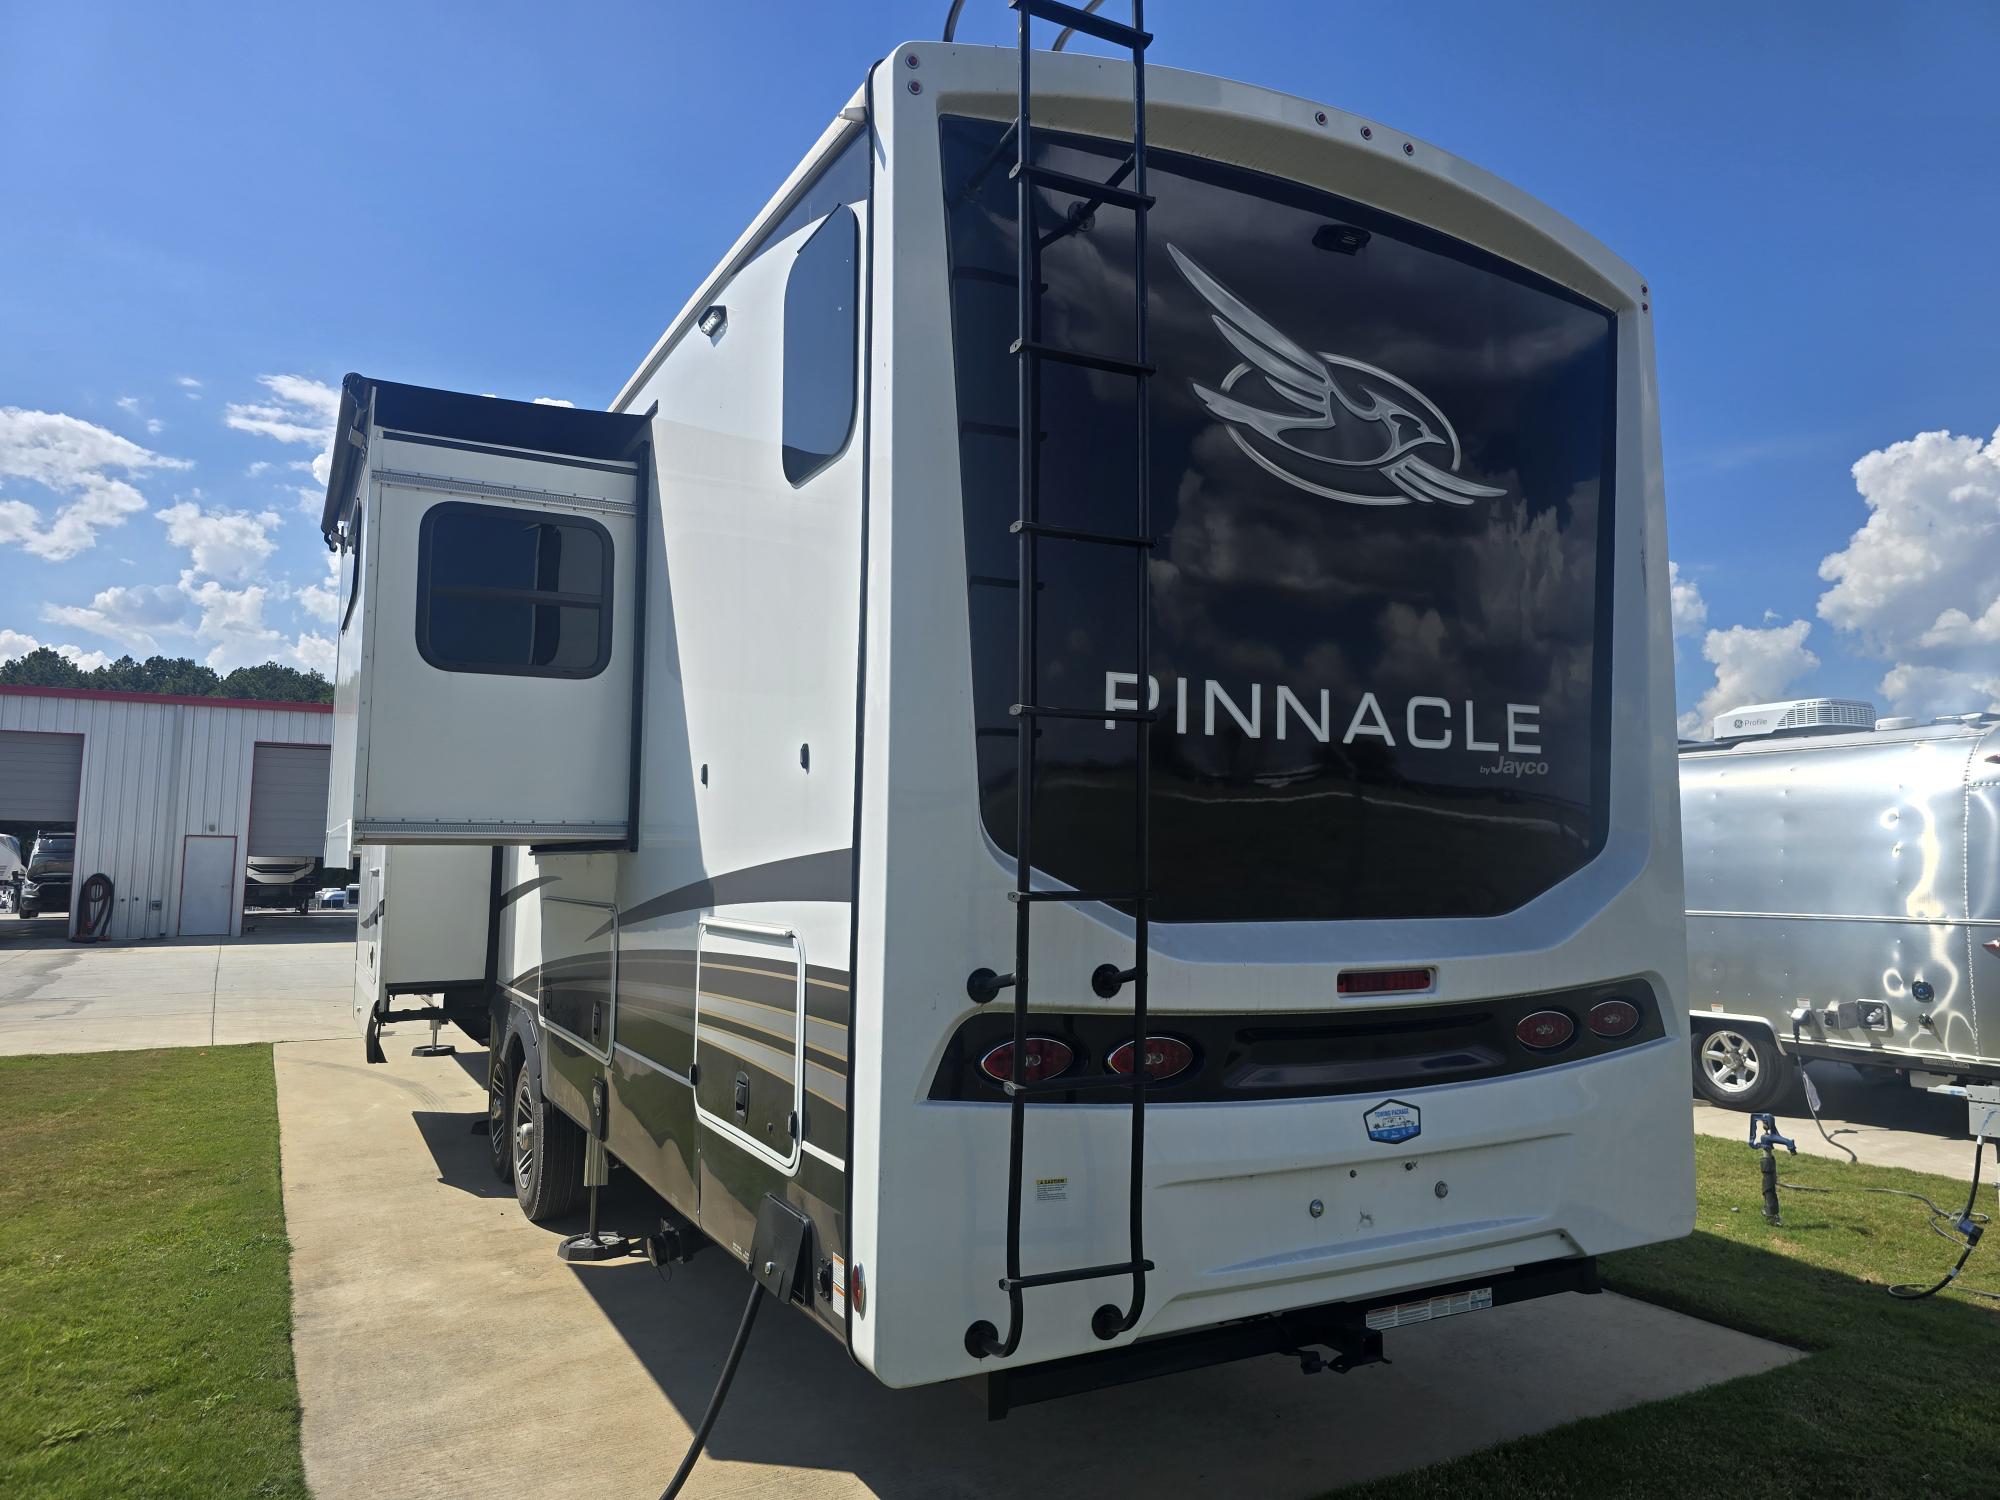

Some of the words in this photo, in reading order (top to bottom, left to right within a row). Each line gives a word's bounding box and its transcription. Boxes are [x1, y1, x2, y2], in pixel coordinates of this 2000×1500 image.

[1104, 671, 1542, 755] PINNACLE
[1744, 719, 1768, 727] Profile
[1480, 765, 1490, 775] by
[1491, 755, 1549, 778] Jayco
